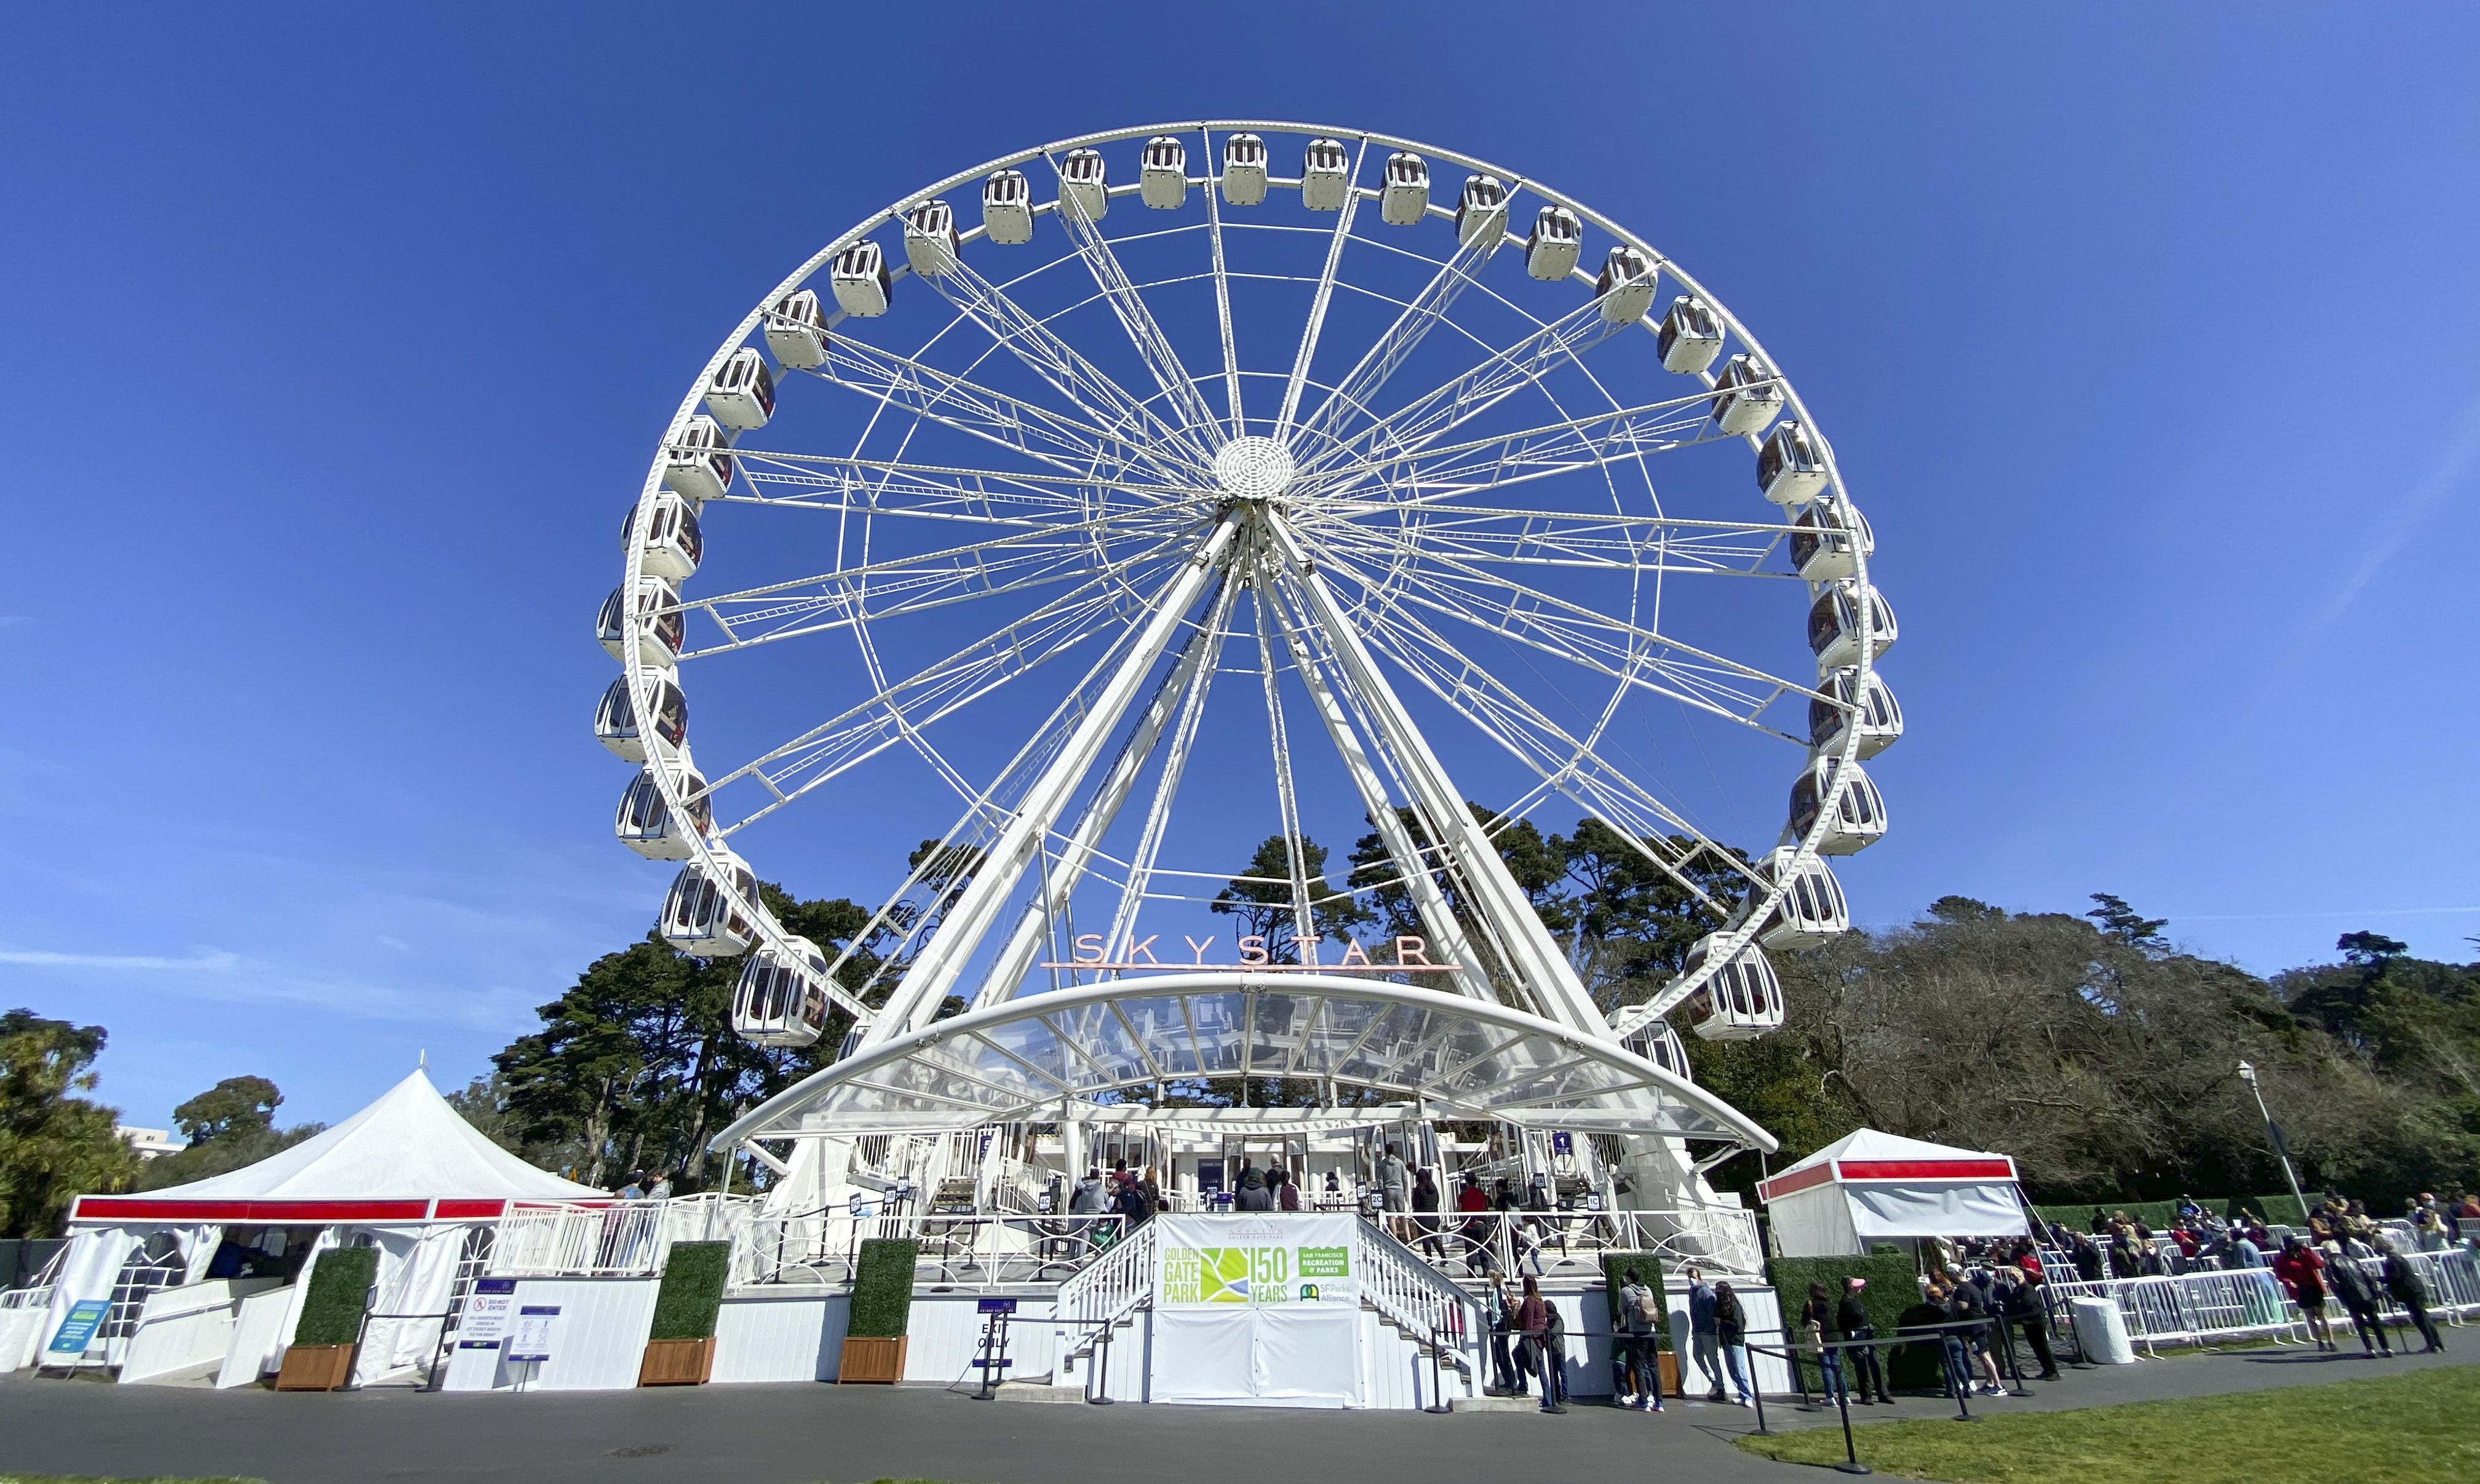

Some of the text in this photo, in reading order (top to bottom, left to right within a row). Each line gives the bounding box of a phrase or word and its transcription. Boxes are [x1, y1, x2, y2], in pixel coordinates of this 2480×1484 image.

[1075, 934, 1432, 966] SKYSTAR
[1559, 1137, 1565, 1146] 1
[851, 1199, 860, 1207] 5C
[1164, 1247, 1199, 1261] GOLDEN
[1164, 1261, 1199, 1282] GATE
[1250, 1246, 1287, 1283] 150
[1163, 1283, 1199, 1303] PARK
[1250, 1284, 1287, 1303] YEARS
